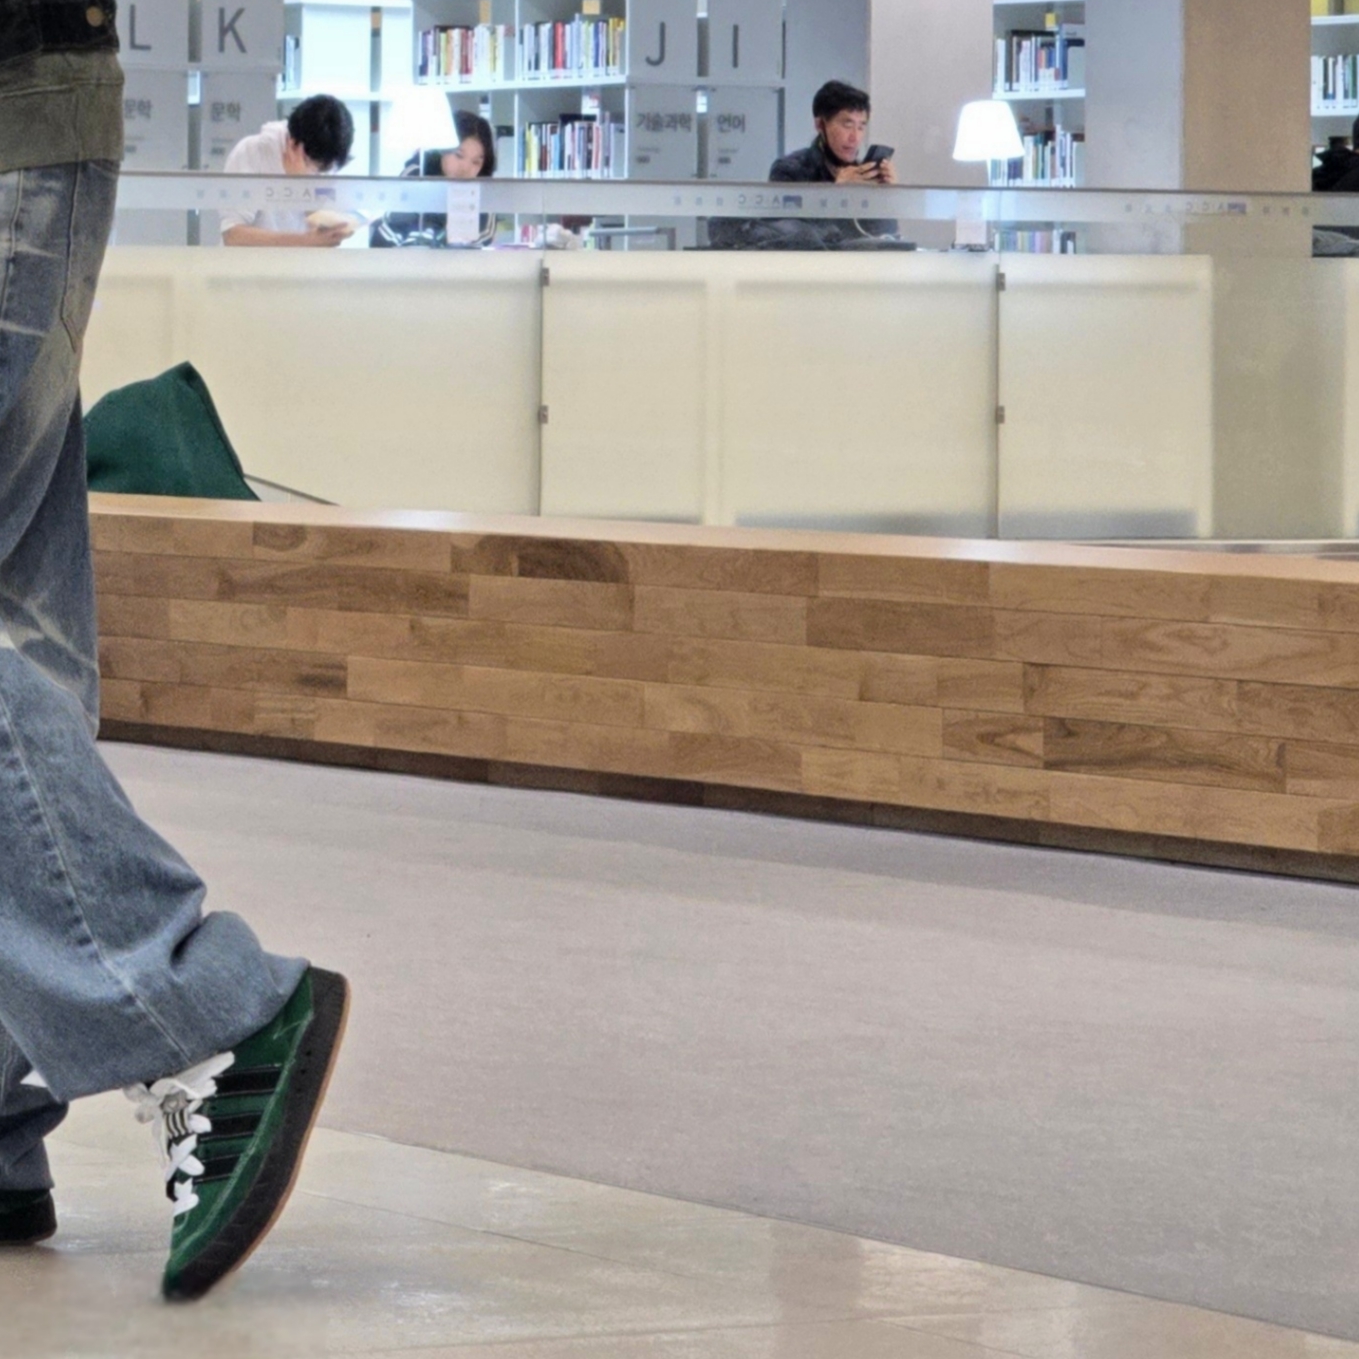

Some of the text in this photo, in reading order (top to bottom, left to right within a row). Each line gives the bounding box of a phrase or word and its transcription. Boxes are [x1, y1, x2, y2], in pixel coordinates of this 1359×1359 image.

[129, 4, 152, 51] L
[218, 7, 247, 53] K
[645, 22, 666, 66] J
[717, 113, 746, 134] 언어
